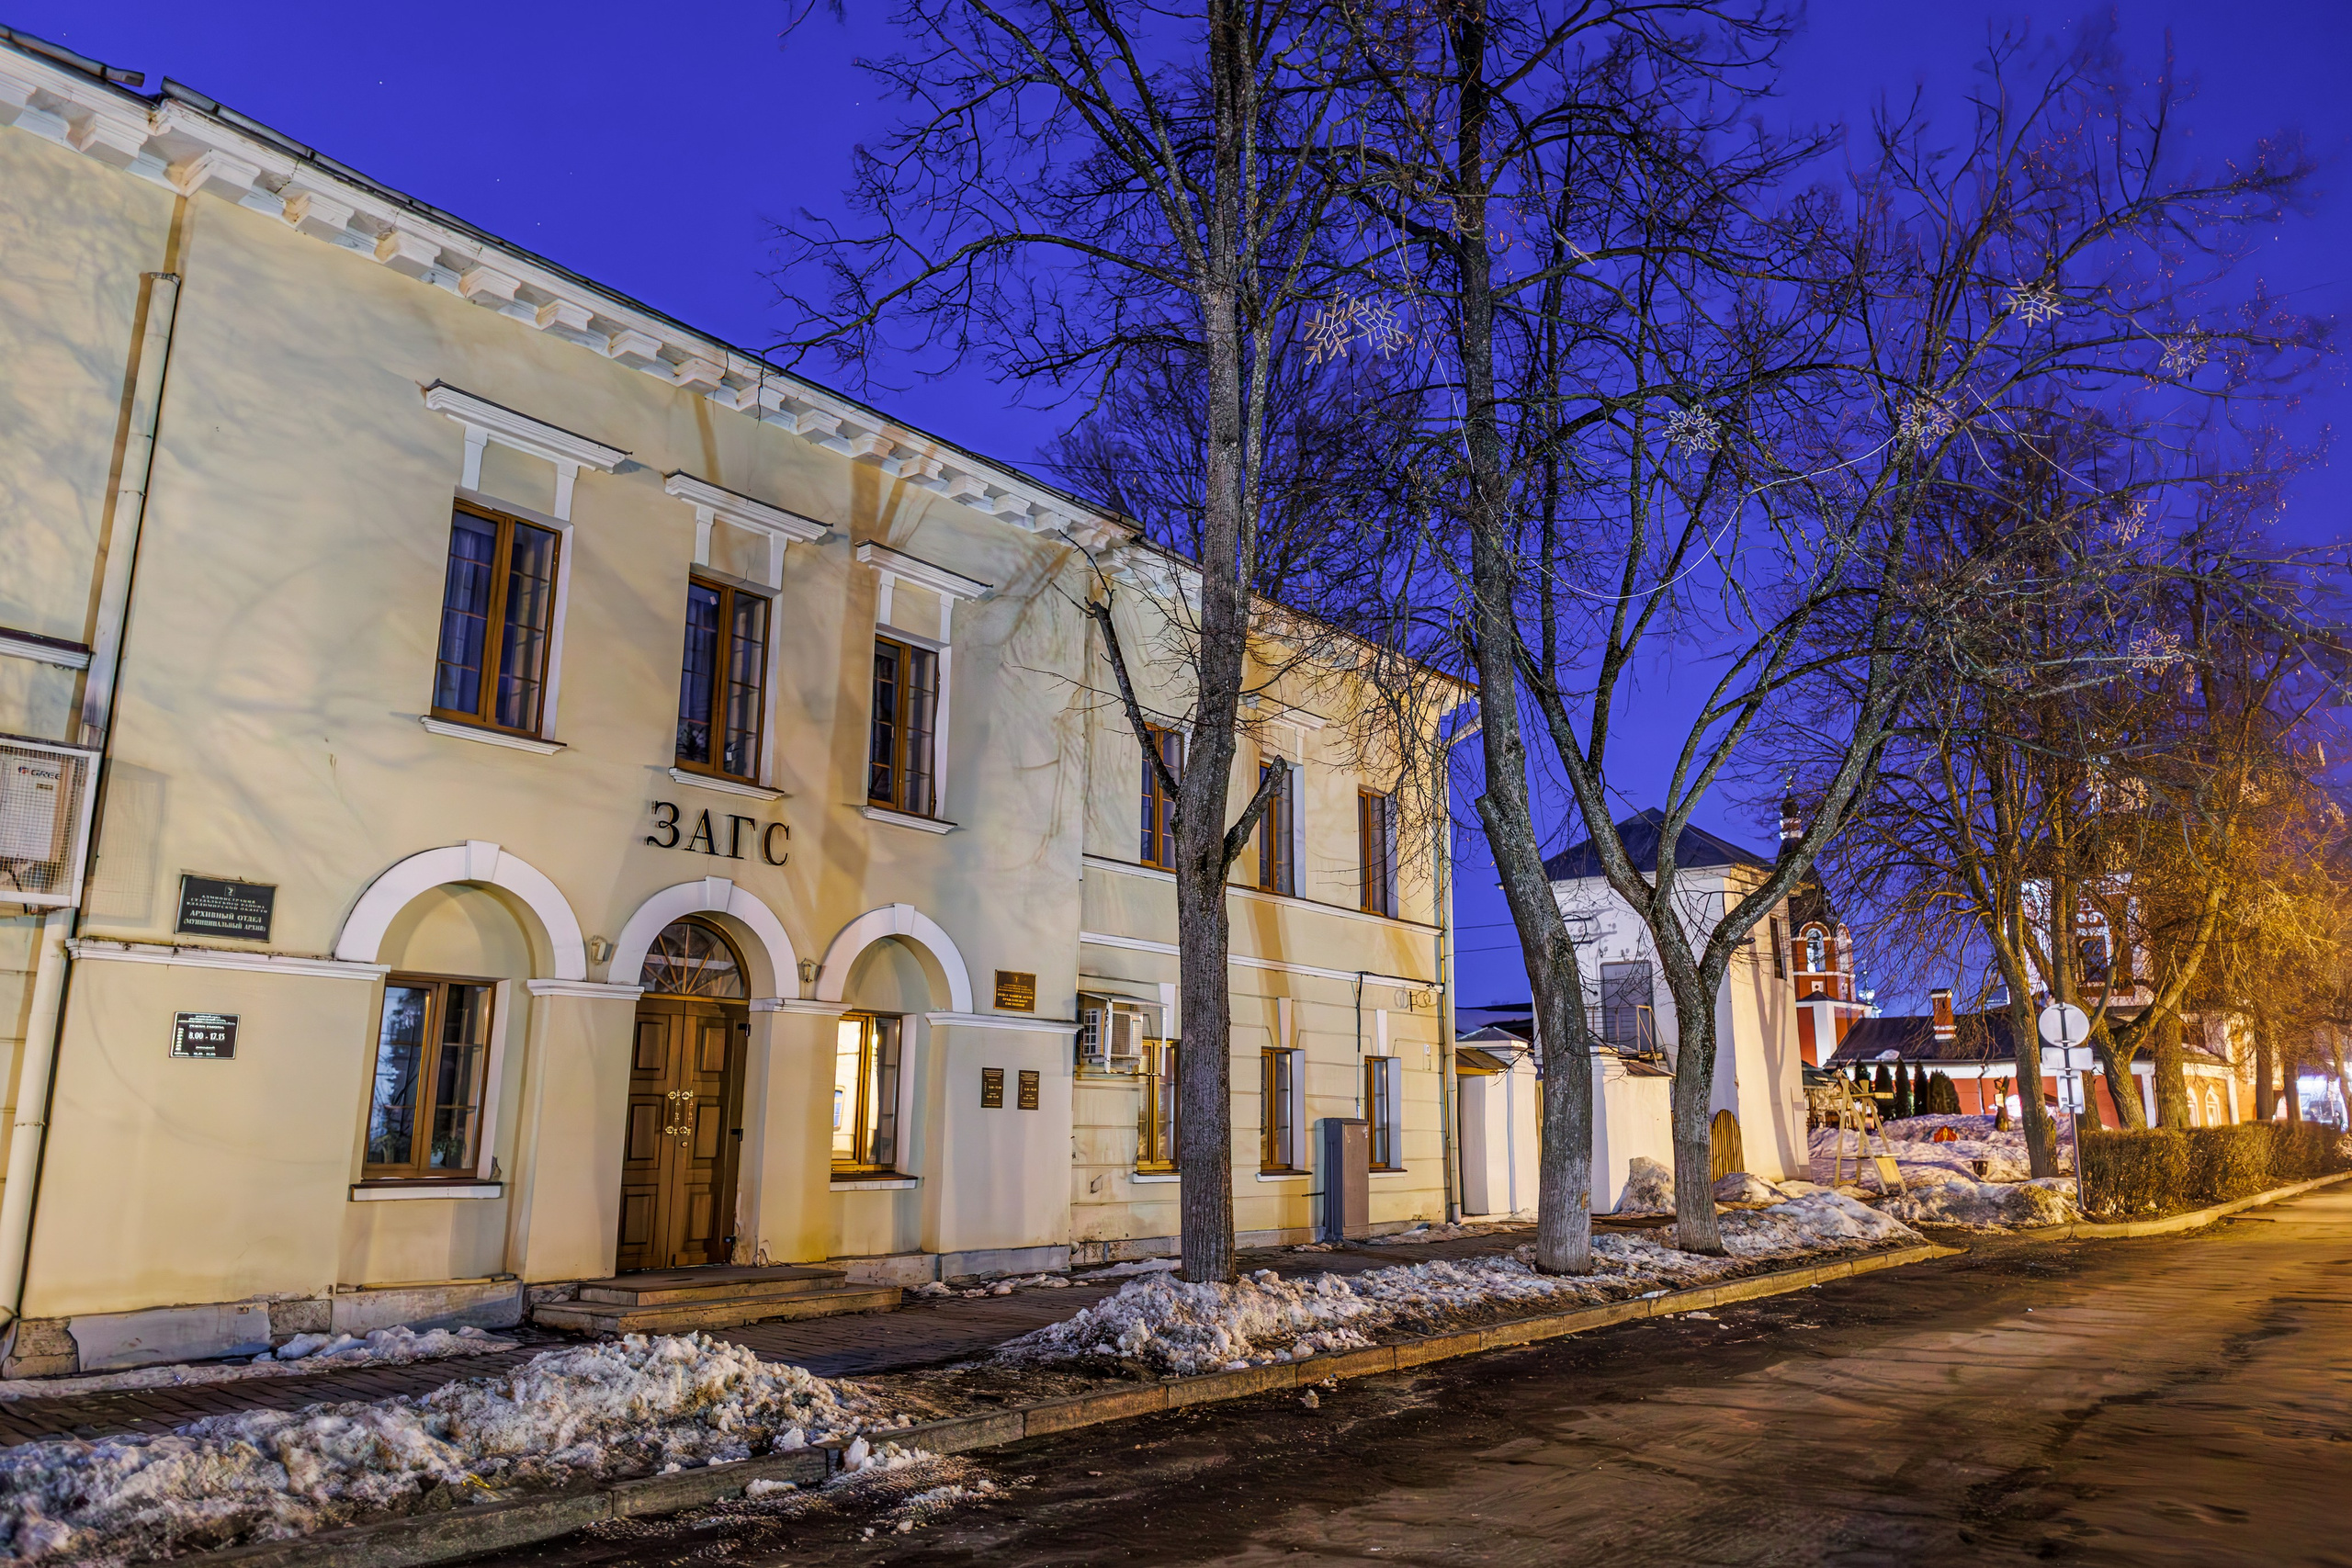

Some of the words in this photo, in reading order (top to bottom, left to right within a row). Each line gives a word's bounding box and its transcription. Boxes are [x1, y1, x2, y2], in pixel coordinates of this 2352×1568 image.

[30, 769, 62, 780] GREE
[644, 800, 792, 866] ЗАГС
[189, 910, 235, 919] АРХИВНЫЙ
